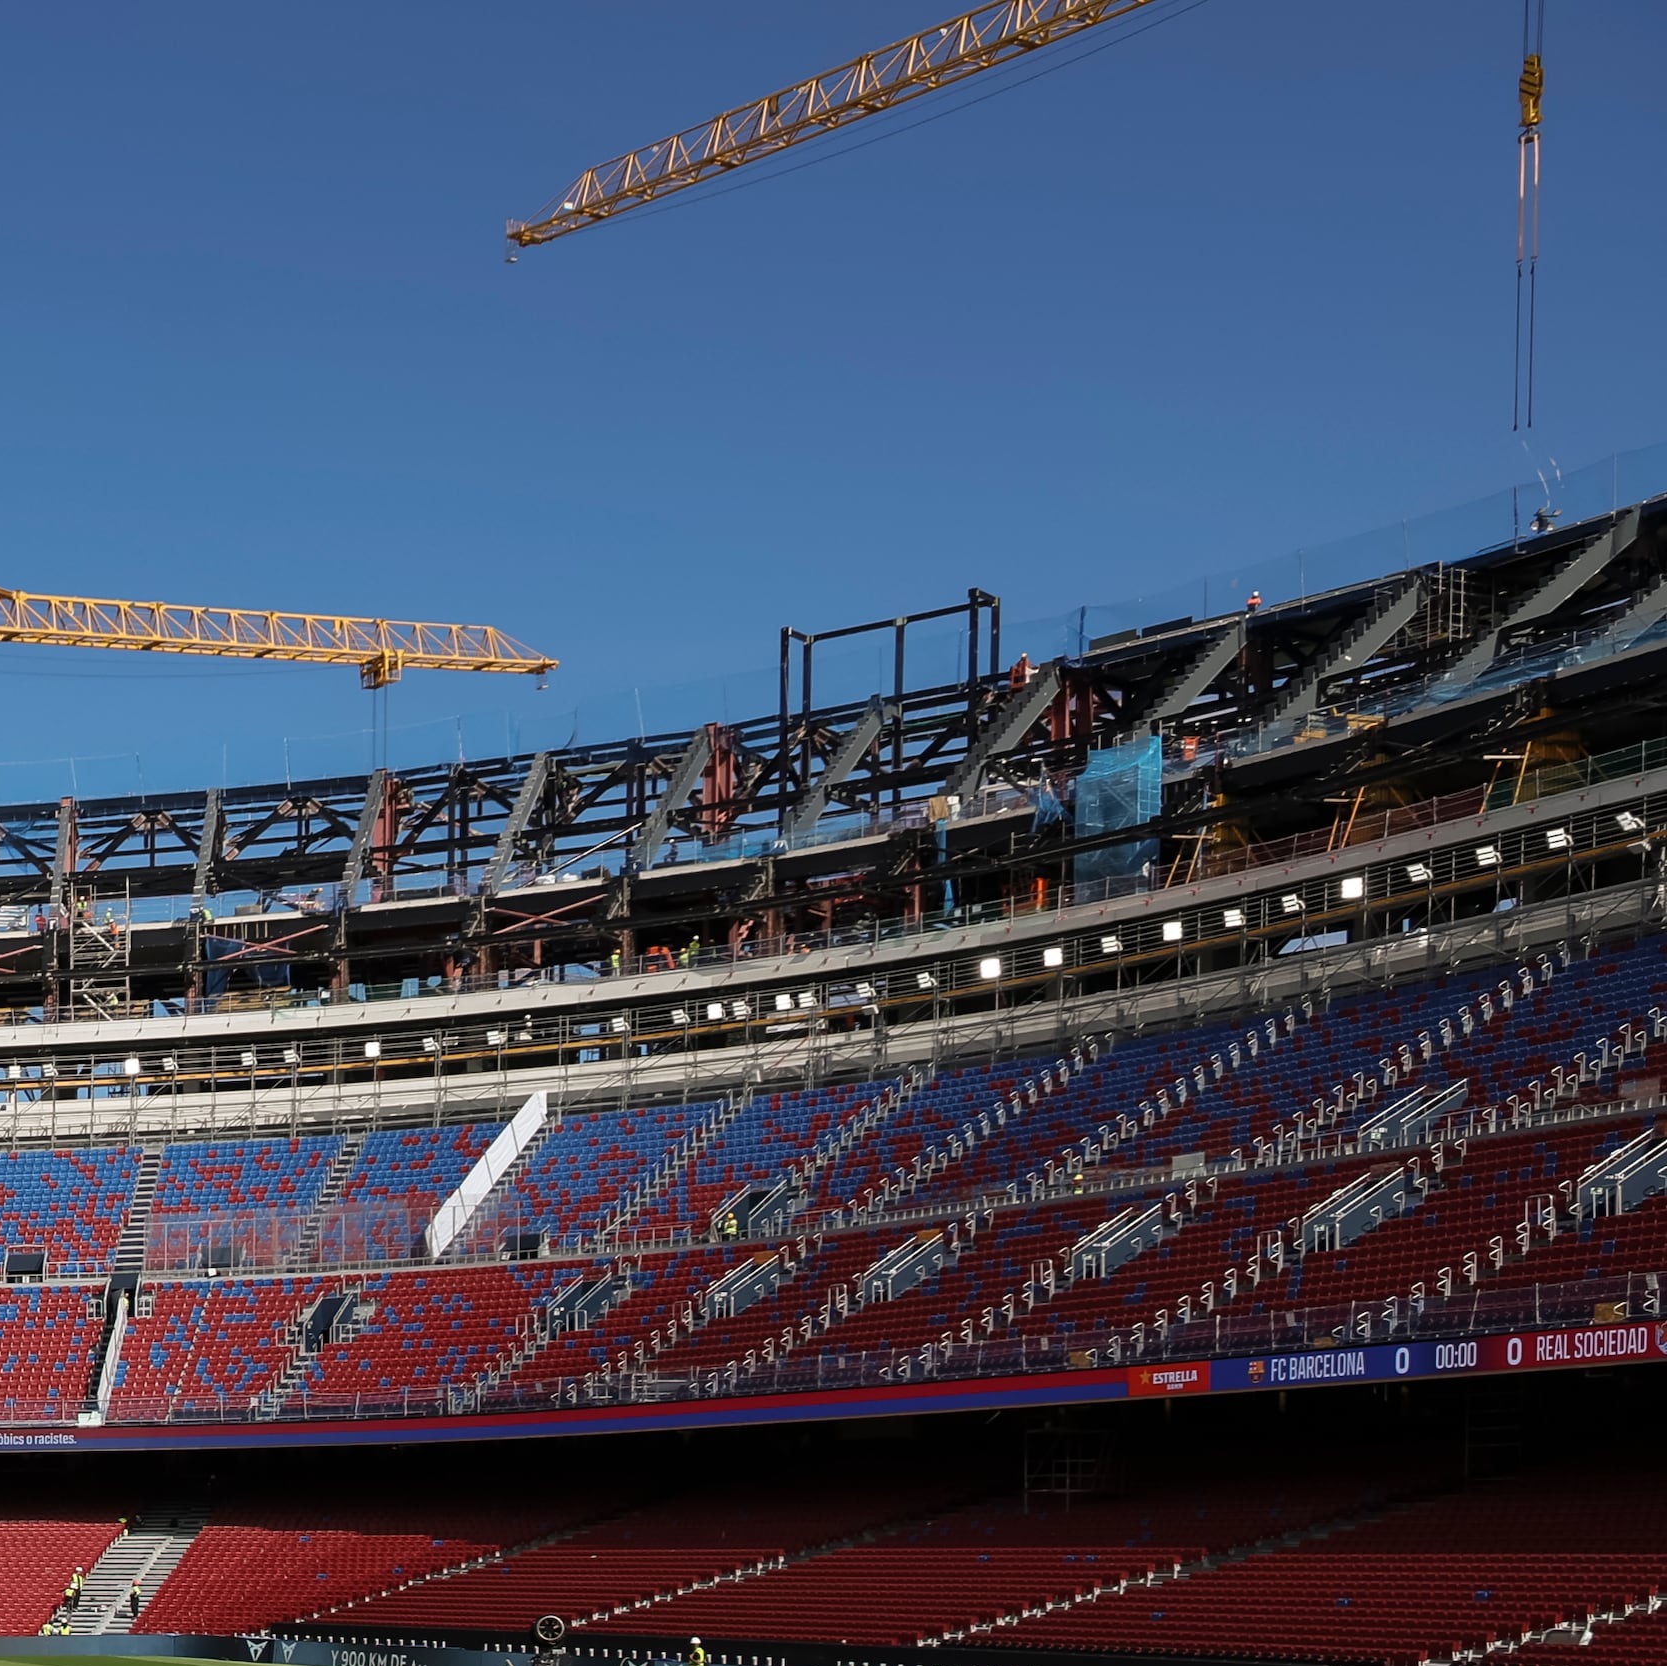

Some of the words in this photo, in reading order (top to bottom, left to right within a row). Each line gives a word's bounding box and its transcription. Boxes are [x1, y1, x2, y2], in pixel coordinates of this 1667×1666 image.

[1270, 1358, 1287, 1382] FC
[1289, 1351, 1365, 1381] BARCELONA
[1395, 1347, 1410, 1374] 0
[1435, 1342, 1477, 1369] 00:00
[1507, 1337, 1522, 1366] 0
[1536, 1331, 1570, 1361] REAL
[1574, 1327, 1648, 1358] SOCIEDAD
[1152, 1369, 1198, 1385] ESTRELLA
[26, 1436, 32, 1445] o
[34, 1433, 77, 1445] racistes.
[331, 1649, 339, 1666] Y
